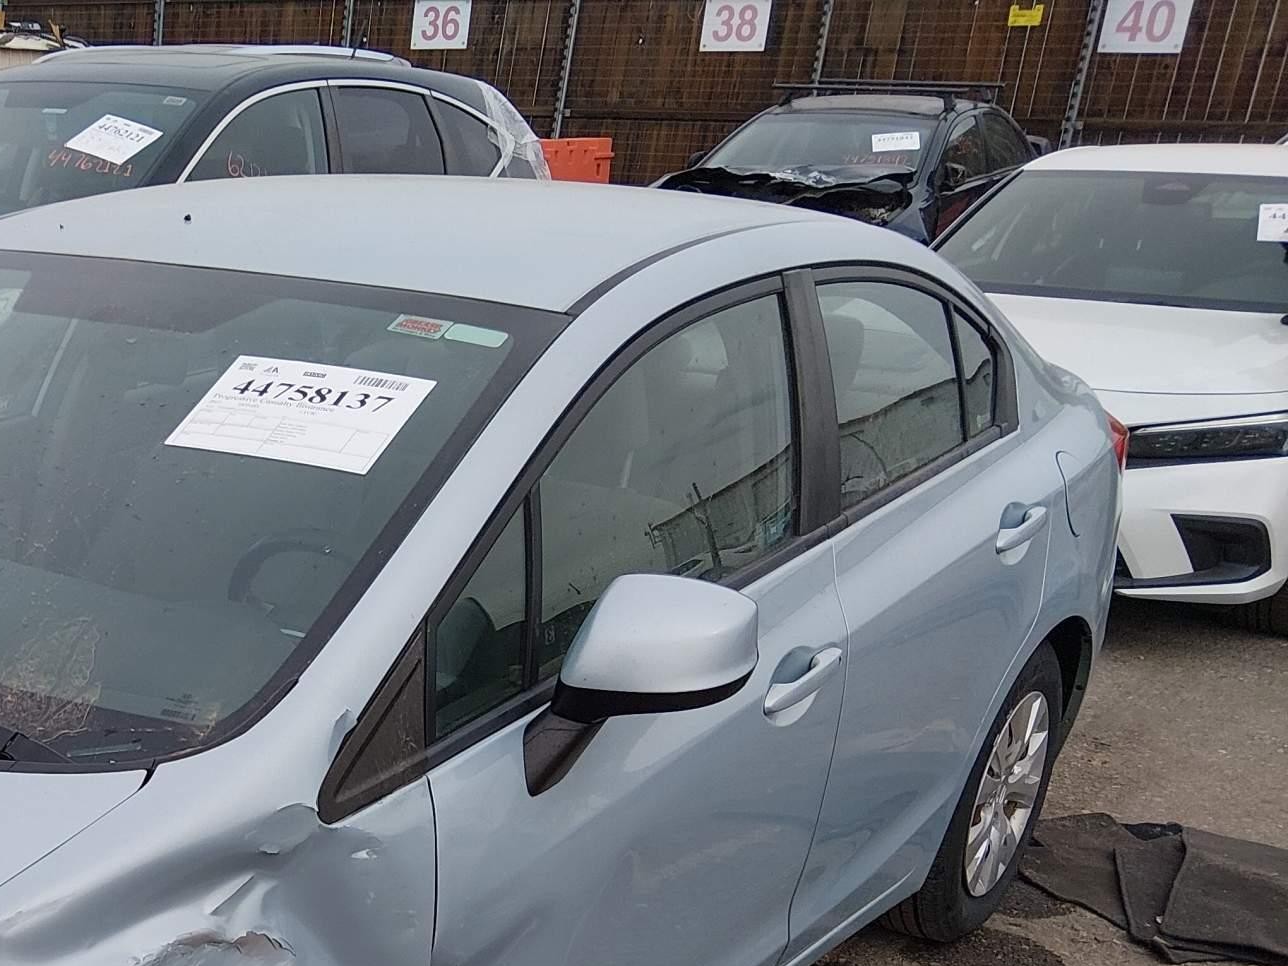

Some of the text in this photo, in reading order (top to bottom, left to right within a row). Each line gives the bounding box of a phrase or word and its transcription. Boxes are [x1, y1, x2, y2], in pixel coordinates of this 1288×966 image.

[421, 6, 460, 41] 36
[712, 5, 758, 42] 38
[1115, 0, 1176, 43] 40
[233, 379, 395, 412] 44758137
